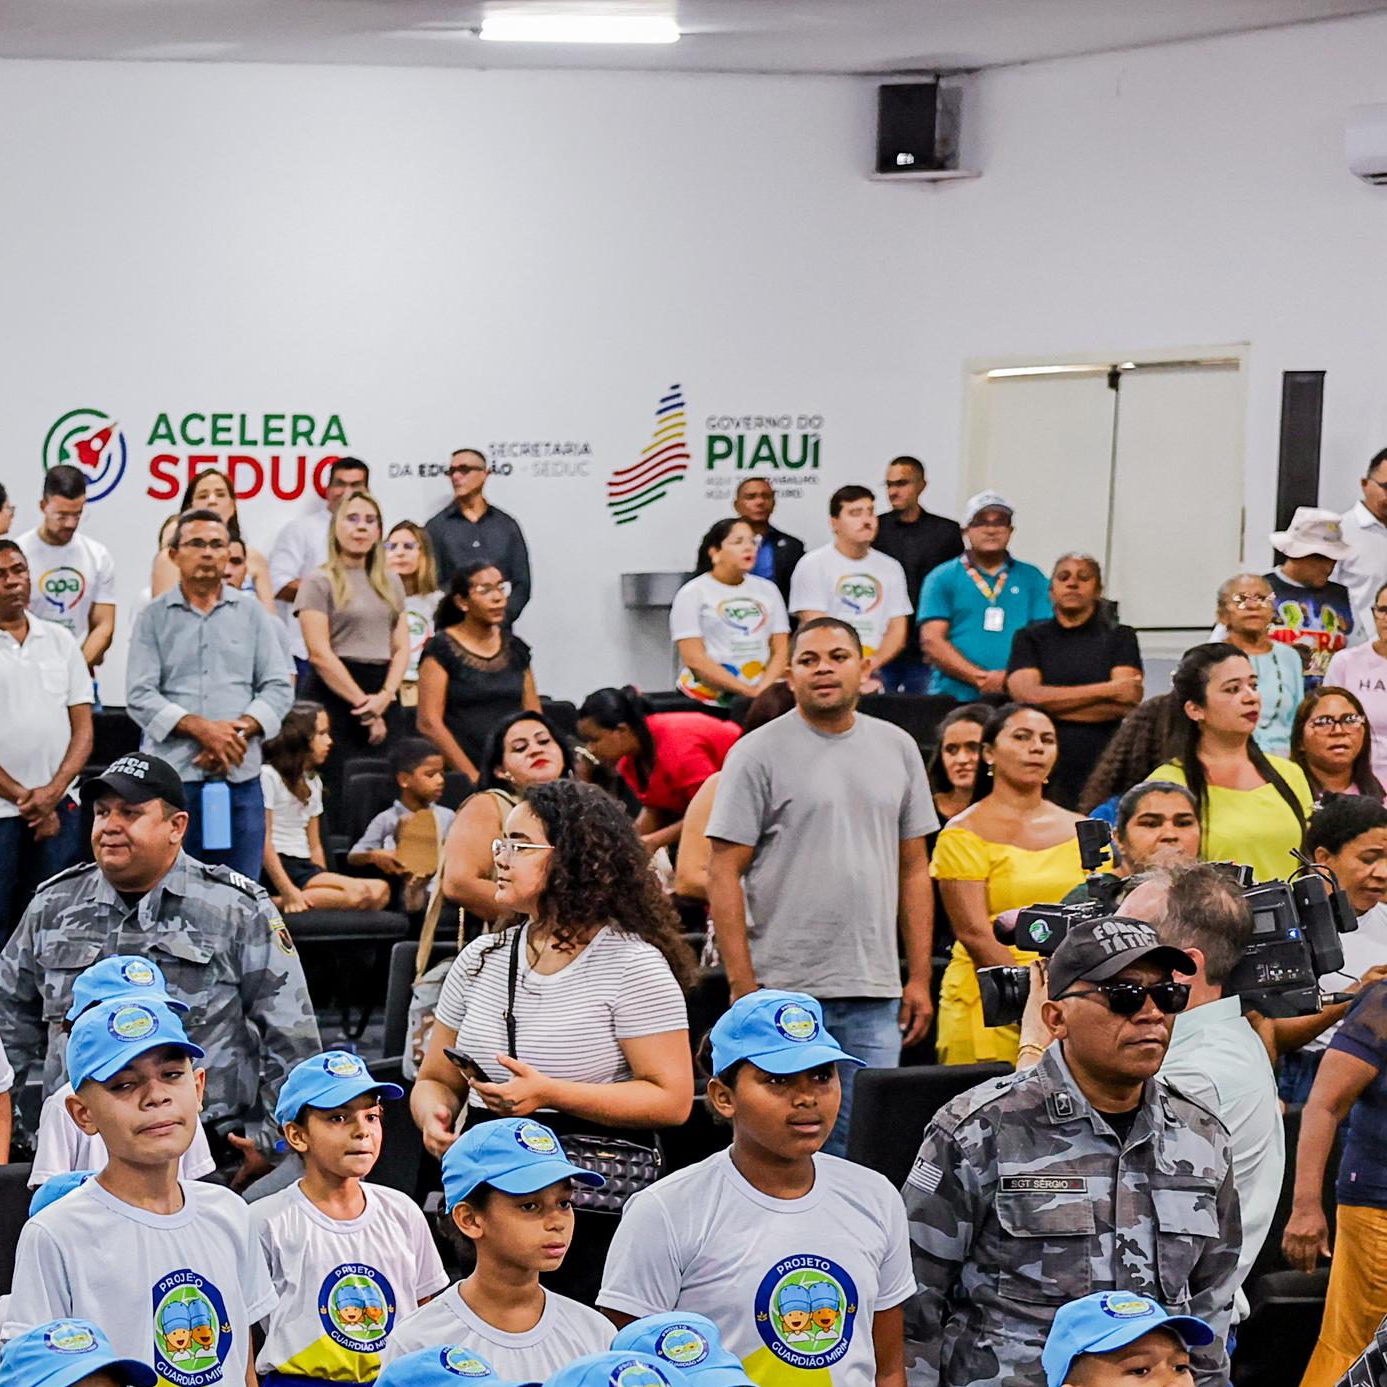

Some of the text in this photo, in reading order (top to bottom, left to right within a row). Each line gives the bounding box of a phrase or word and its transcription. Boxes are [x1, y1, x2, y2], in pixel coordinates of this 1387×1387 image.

[147, 413, 348, 446] ACELERA
[706, 415, 824, 431] GOVERNO DO
[489, 441, 592, 457] SECRETARIA
[707, 433, 821, 469] PIAUÍ
[389, 463, 412, 478] DA
[532, 461, 590, 477] SEDUC
[45, 579, 79, 598] opa
[1011, 1178, 1069, 1189] SGT SÉRGIO
[776, 1257, 831, 1275] PROJETO
[159, 1272, 204, 1293] PROJEO
[330, 1330, 374, 1351] GUARDIÃO
[771, 1340, 824, 1367] GUARDIÃO
[156, 1360, 224, 1386] GUARDIÃO MIR
